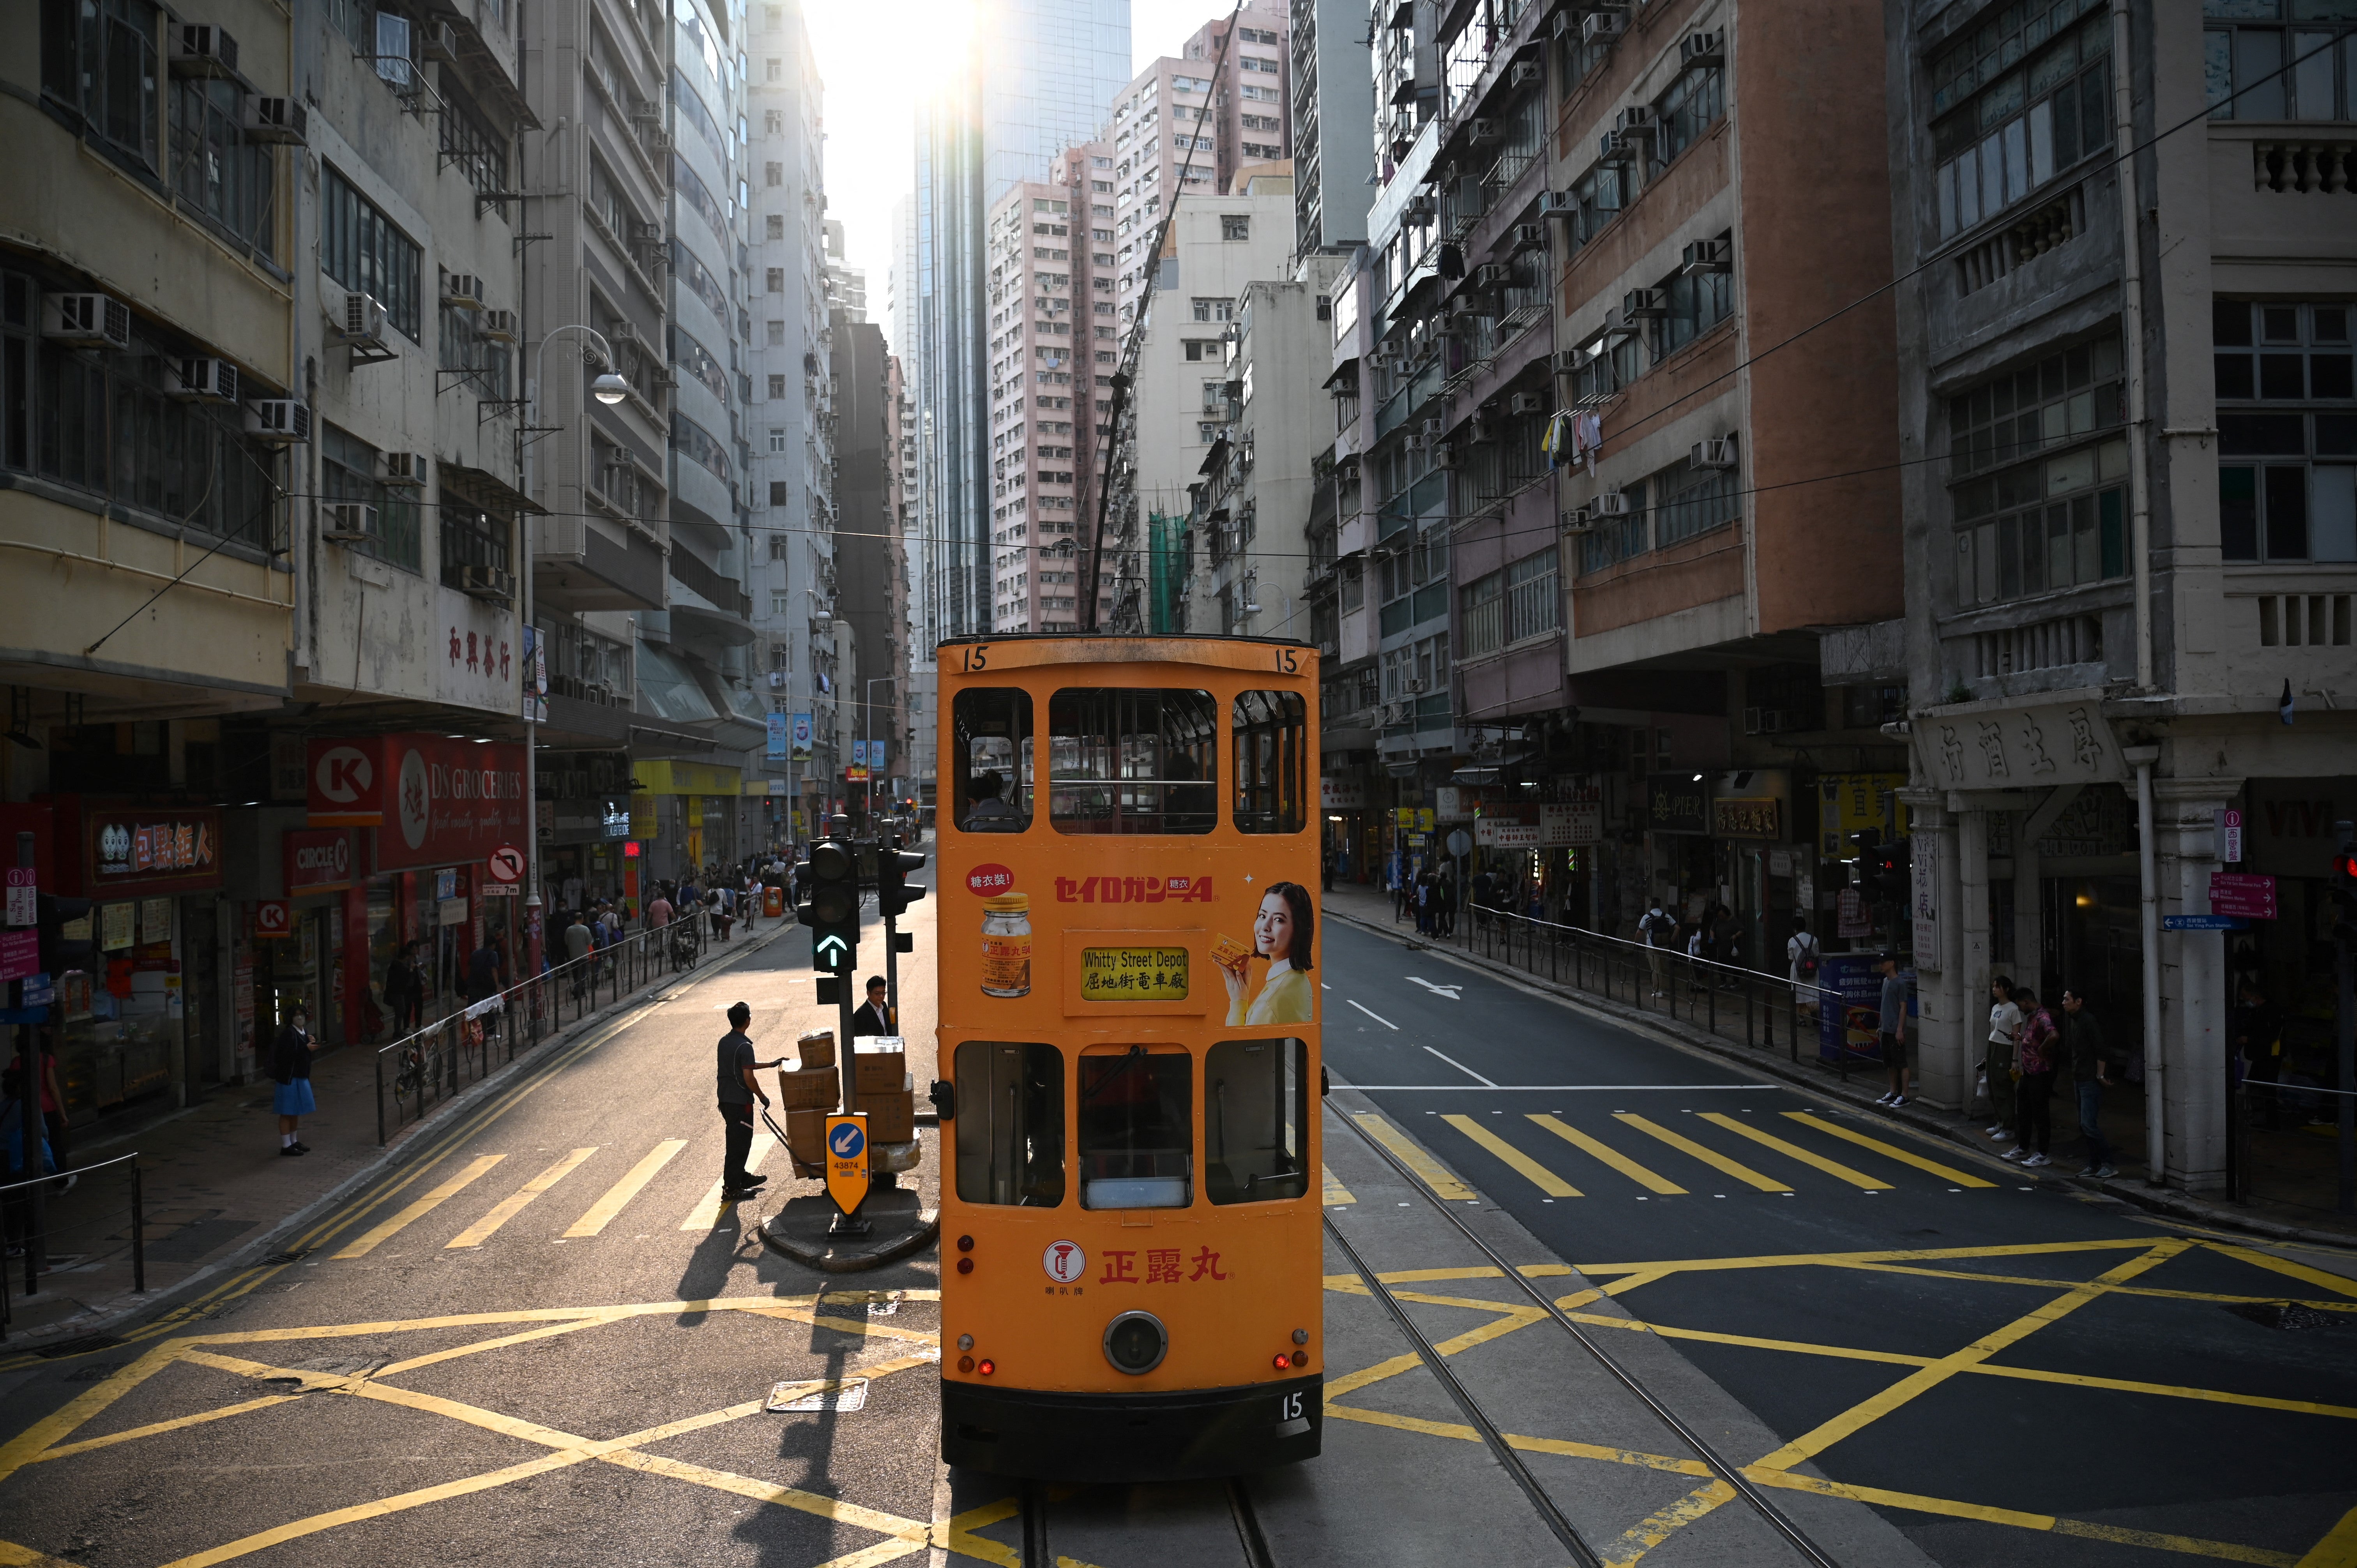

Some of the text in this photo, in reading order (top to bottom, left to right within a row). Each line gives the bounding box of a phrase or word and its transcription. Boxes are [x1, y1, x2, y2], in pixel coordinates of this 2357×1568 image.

[964, 646, 988, 672] 15
[1276, 650, 1297, 674] 15
[431, 763, 521, 799] DS GROCERIES
[1672, 796, 1703, 819] PIER
[432, 809, 450, 841] Great
[451, 810, 474, 841] variety
[480, 807, 502, 839] quality
[1917, 838, 1927, 852] Vi
[2228, 828, 2238, 862] 西營盤
[297, 846, 334, 869] CIRCLE
[1917, 854, 1927, 867] Vi
[971, 873, 1010, 888] 糖衣裝!
[16, 906, 24, 923] Ying
[989, 945, 1021, 956] 正露丸
[1084, 951, 1186, 971] Whitty Street Depot
[1085, 971, 1187, 991] 屈地街電車廠
[1099, 1245, 1227, 1285] 正露丸
[1045, 1286, 1083, 1296] 喇叭牌
[1283, 1391, 1302, 1420] 15
